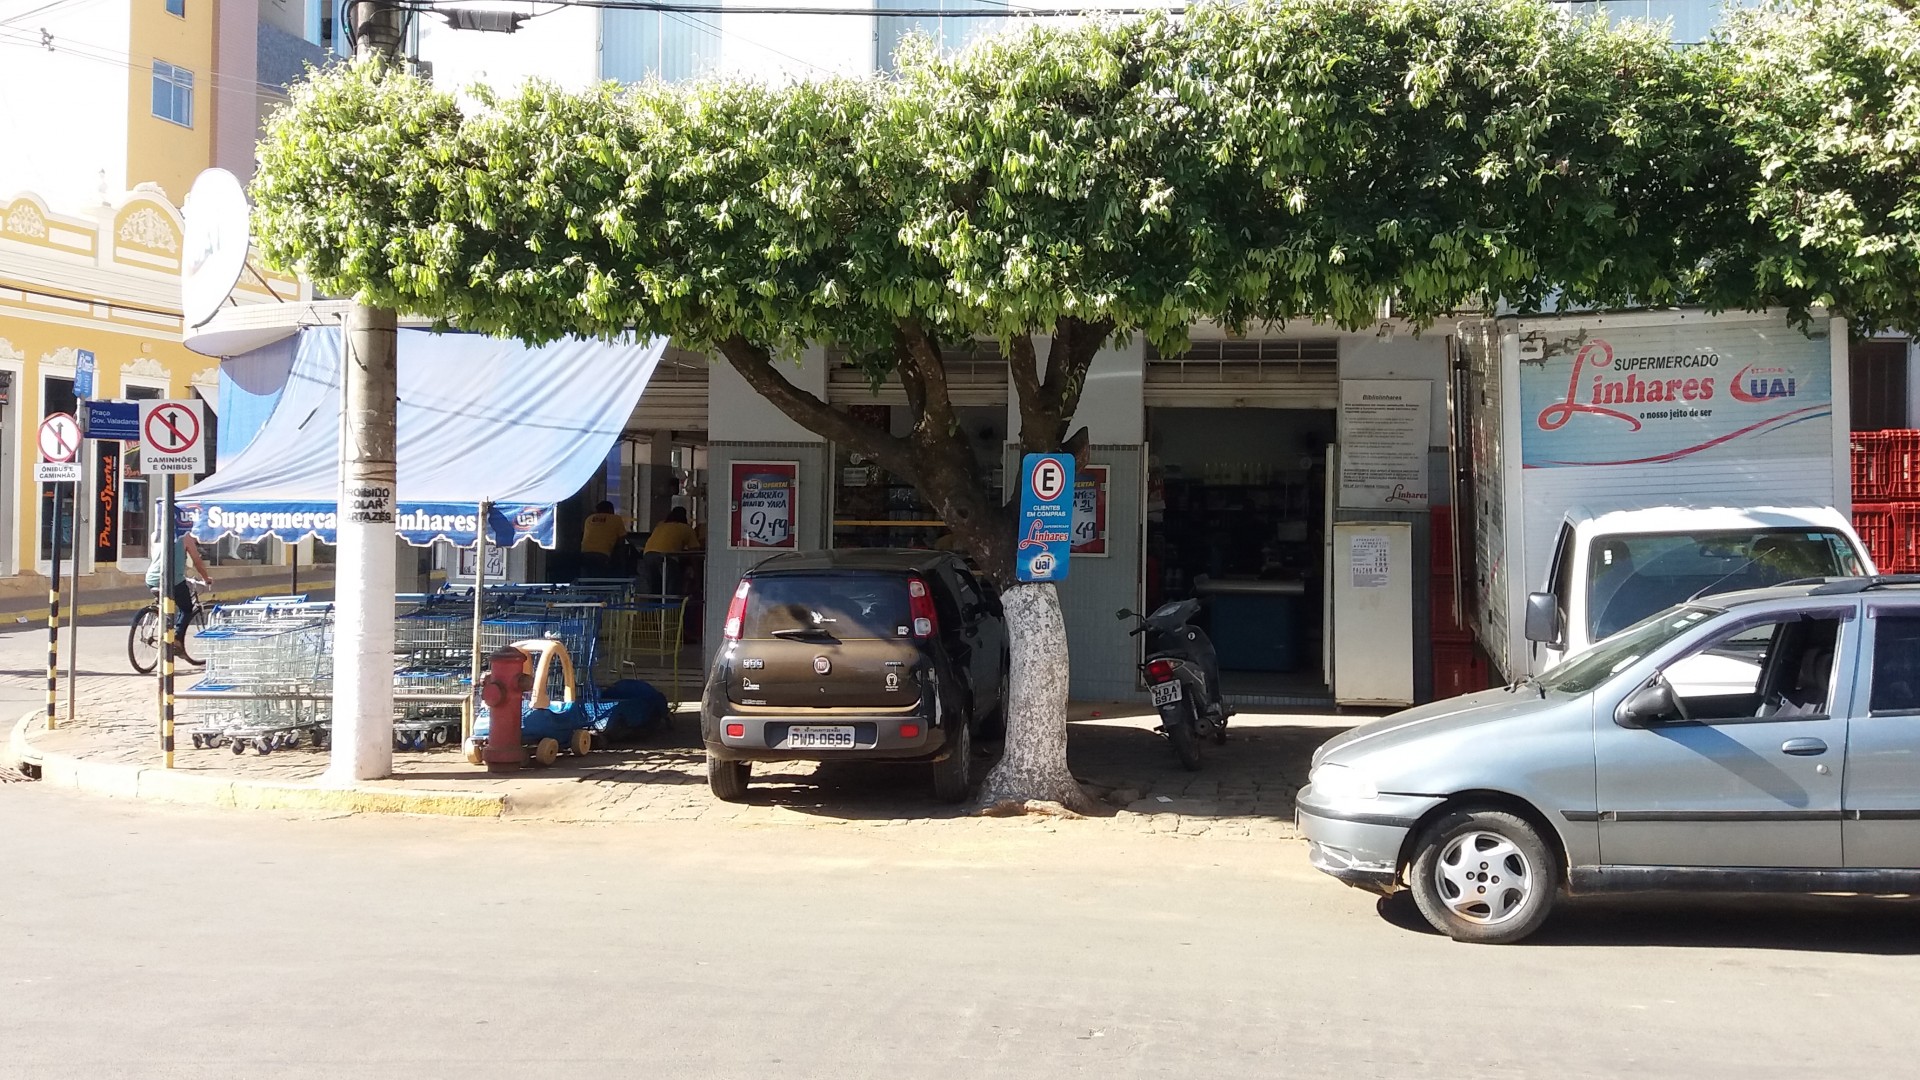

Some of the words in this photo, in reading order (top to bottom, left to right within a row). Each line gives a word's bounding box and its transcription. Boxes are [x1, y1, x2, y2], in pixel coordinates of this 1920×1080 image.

[1613, 353, 1719, 371] SUPERMERCADO
[1537, 339, 1714, 432] Linhares
[1750, 378, 1795, 398] UAI
[1646, 411, 1668, 419] nosso
[1670, 409, 1688, 420] jeito
[1689, 408, 1698, 417] de
[1700, 409, 1712, 417] ser
[107, 418, 139, 426] Valadares
[147, 456, 198, 464] CAMINHÕES
[160, 463, 193, 471] ÔNIBUS
[1042, 468, 1055, 491] E
[1384, 483, 1427, 504] Linhares
[207, 505, 337, 532] Supermerca
[395, 509, 477, 532] inhares
[516, 511, 539, 527] uai
[347, 511, 391, 521] ARTAZES
[1018, 518, 1069, 551] Linhares
[1155, 685, 1177, 697] HDA
[1155, 692, 1177, 705] 6971
[791, 733, 852, 746] PWD-0696
